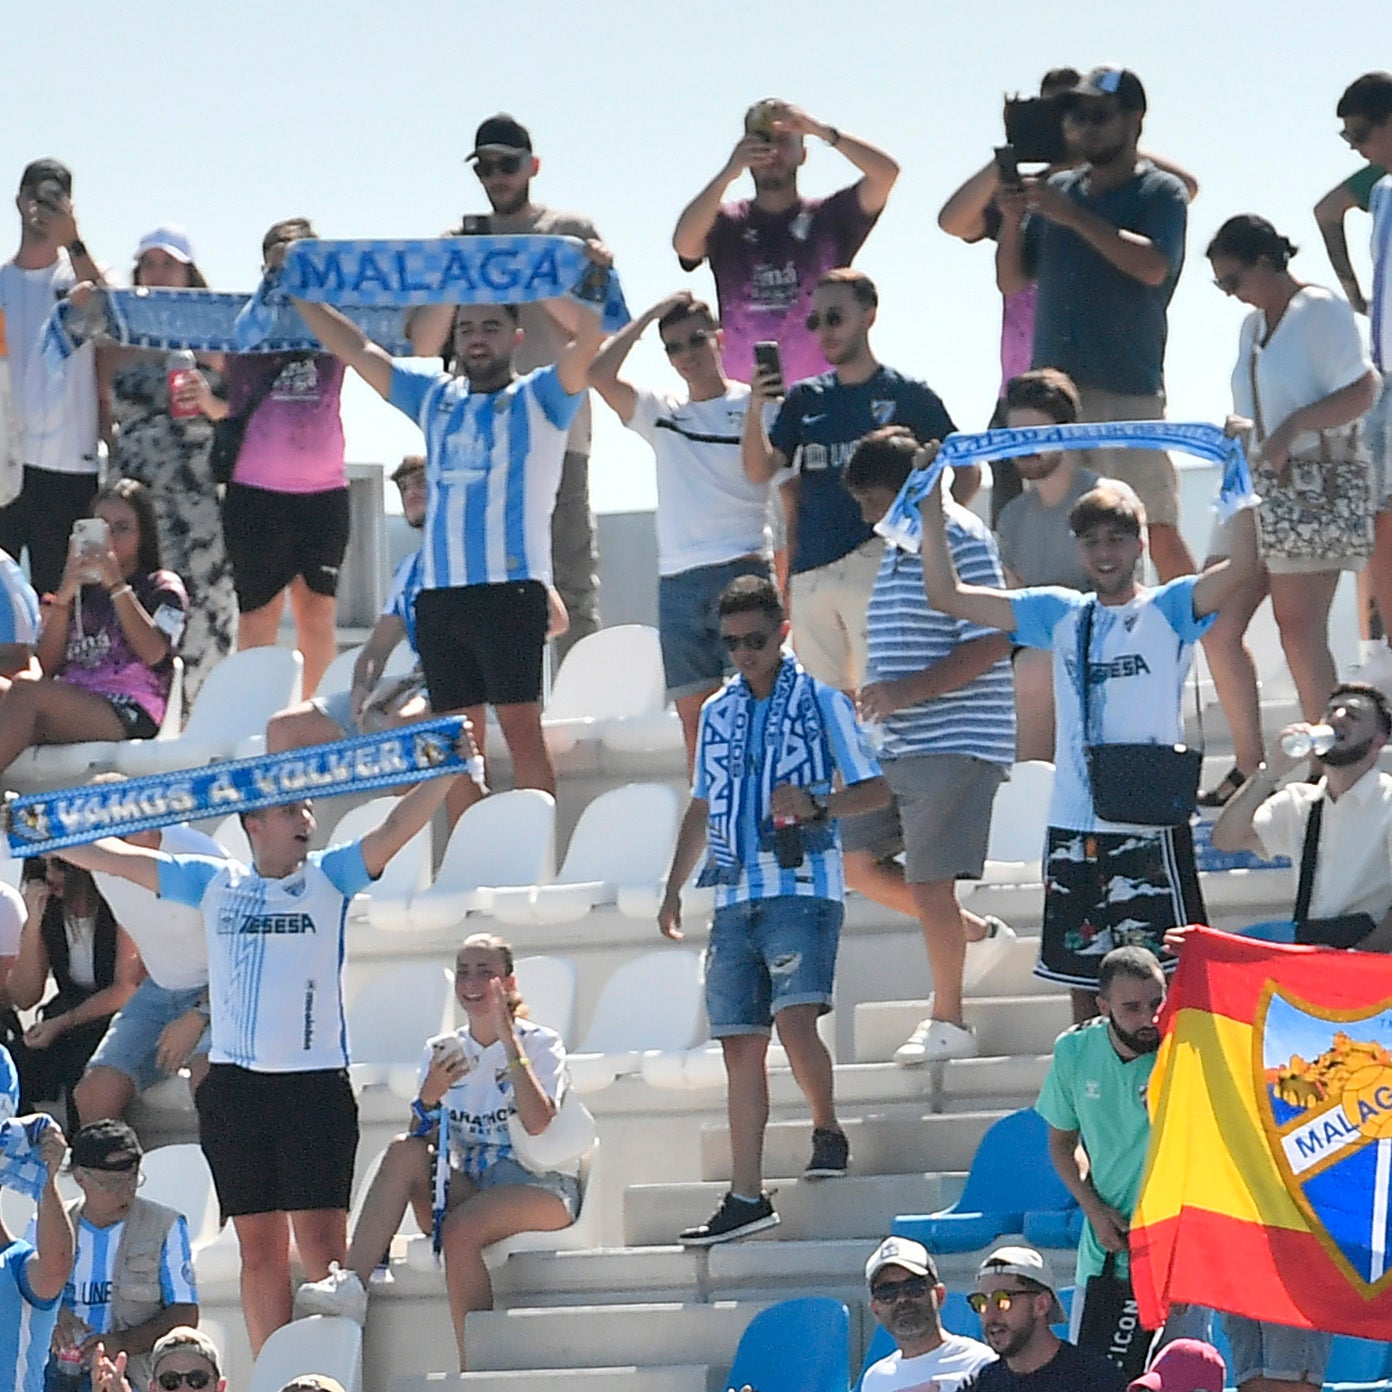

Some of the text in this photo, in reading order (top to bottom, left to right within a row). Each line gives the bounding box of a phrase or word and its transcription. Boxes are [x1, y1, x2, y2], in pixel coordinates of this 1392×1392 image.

[295, 249, 560, 293] MALAGA
[57, 739, 405, 832] VAMOS A VOLVER
[240, 913, 317, 934] TESESA
